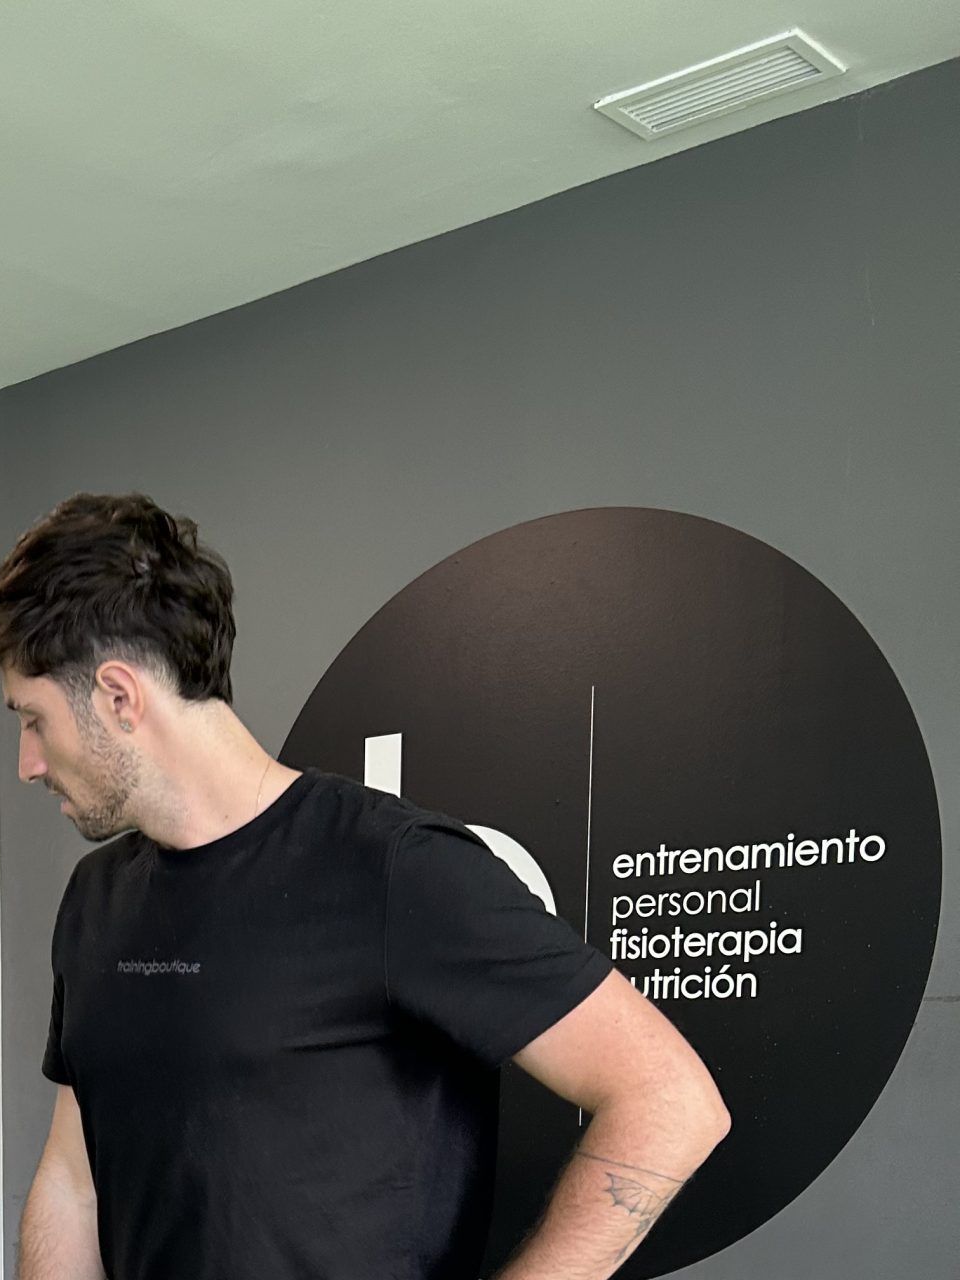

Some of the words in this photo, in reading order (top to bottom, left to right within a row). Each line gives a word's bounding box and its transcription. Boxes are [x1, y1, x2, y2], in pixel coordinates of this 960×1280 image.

[612, 829, 886, 878] entrenamiento
[612, 880, 761, 925] personal
[610, 921, 802, 962] fisioterapia
[117, 959, 201, 976] trainingboutique
[630, 964, 757, 999] utrición
